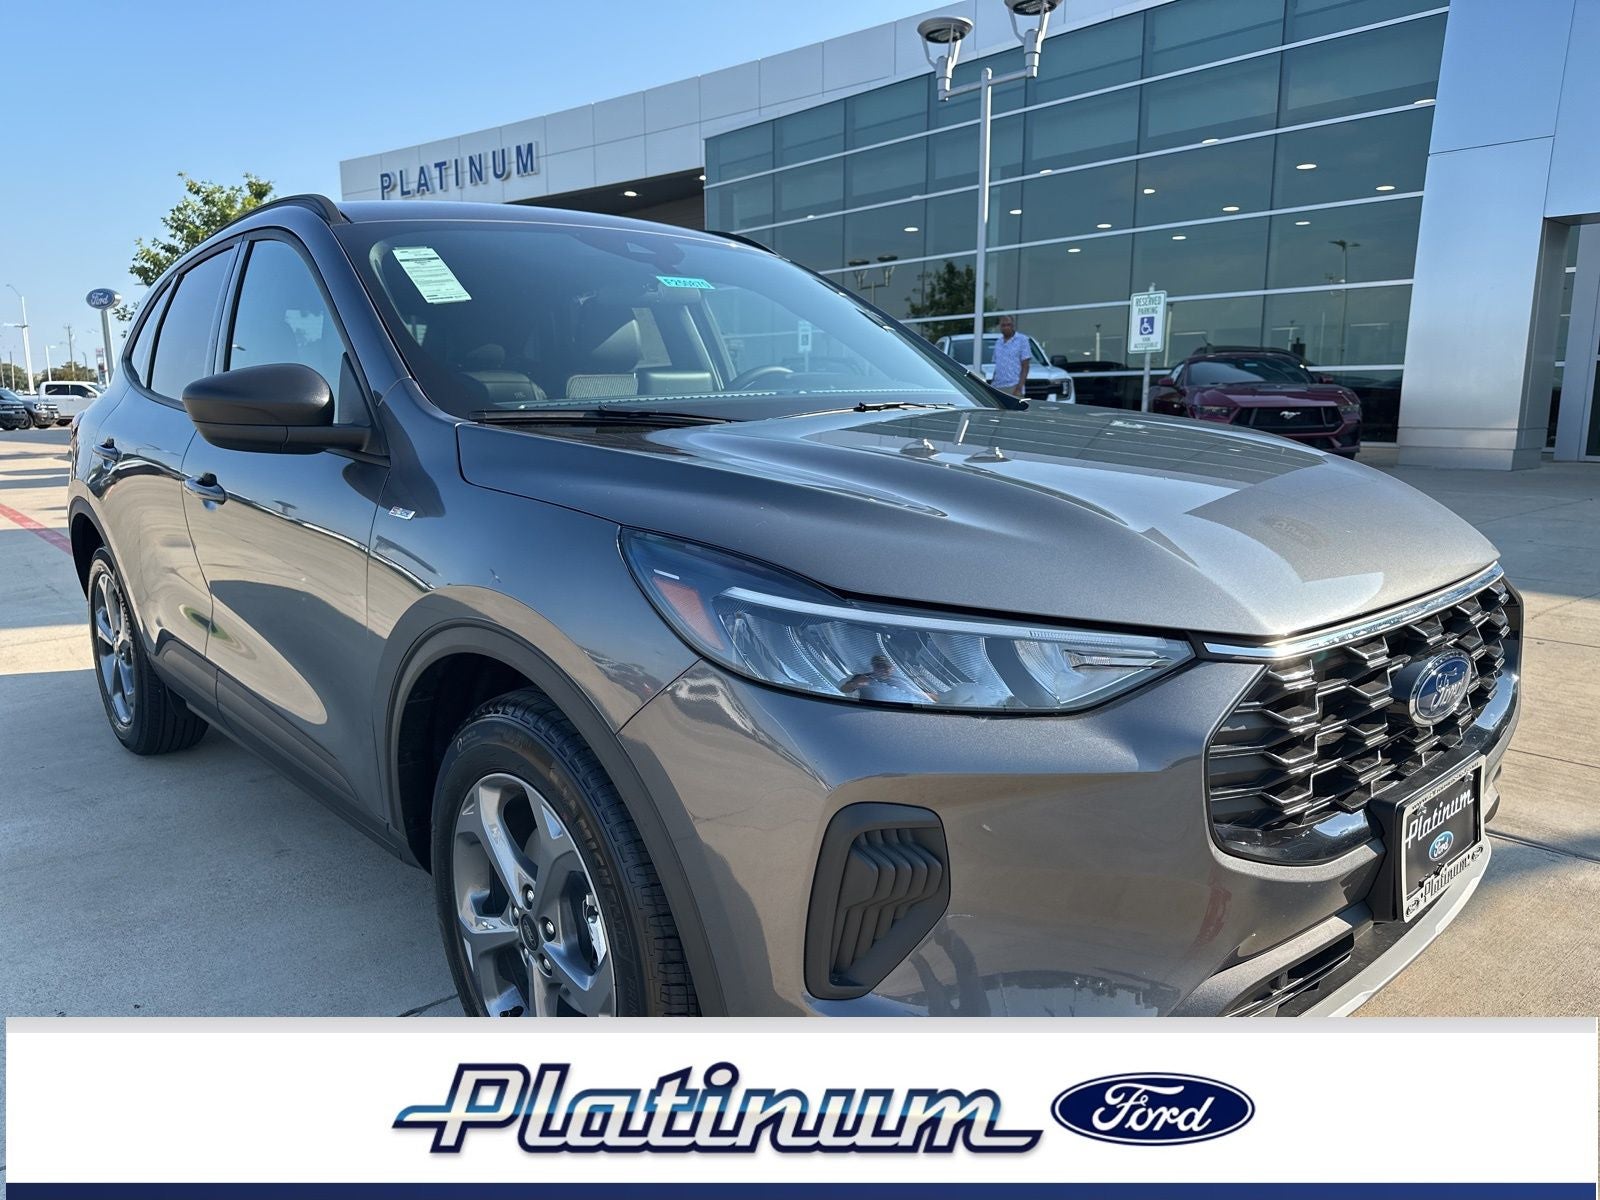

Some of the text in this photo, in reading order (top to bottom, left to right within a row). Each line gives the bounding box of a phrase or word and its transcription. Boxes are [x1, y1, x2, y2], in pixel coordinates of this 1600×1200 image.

[380, 142, 535, 200] PLATINUM
[90, 292, 109, 305] Ford
[1135, 295, 1161, 307] RESERVED
[1137, 305, 1159, 315] PARKING
[1430, 666, 1466, 712] Ford
[1405, 789, 1475, 849] Platinum
[1433, 836, 1450, 858] Ford
